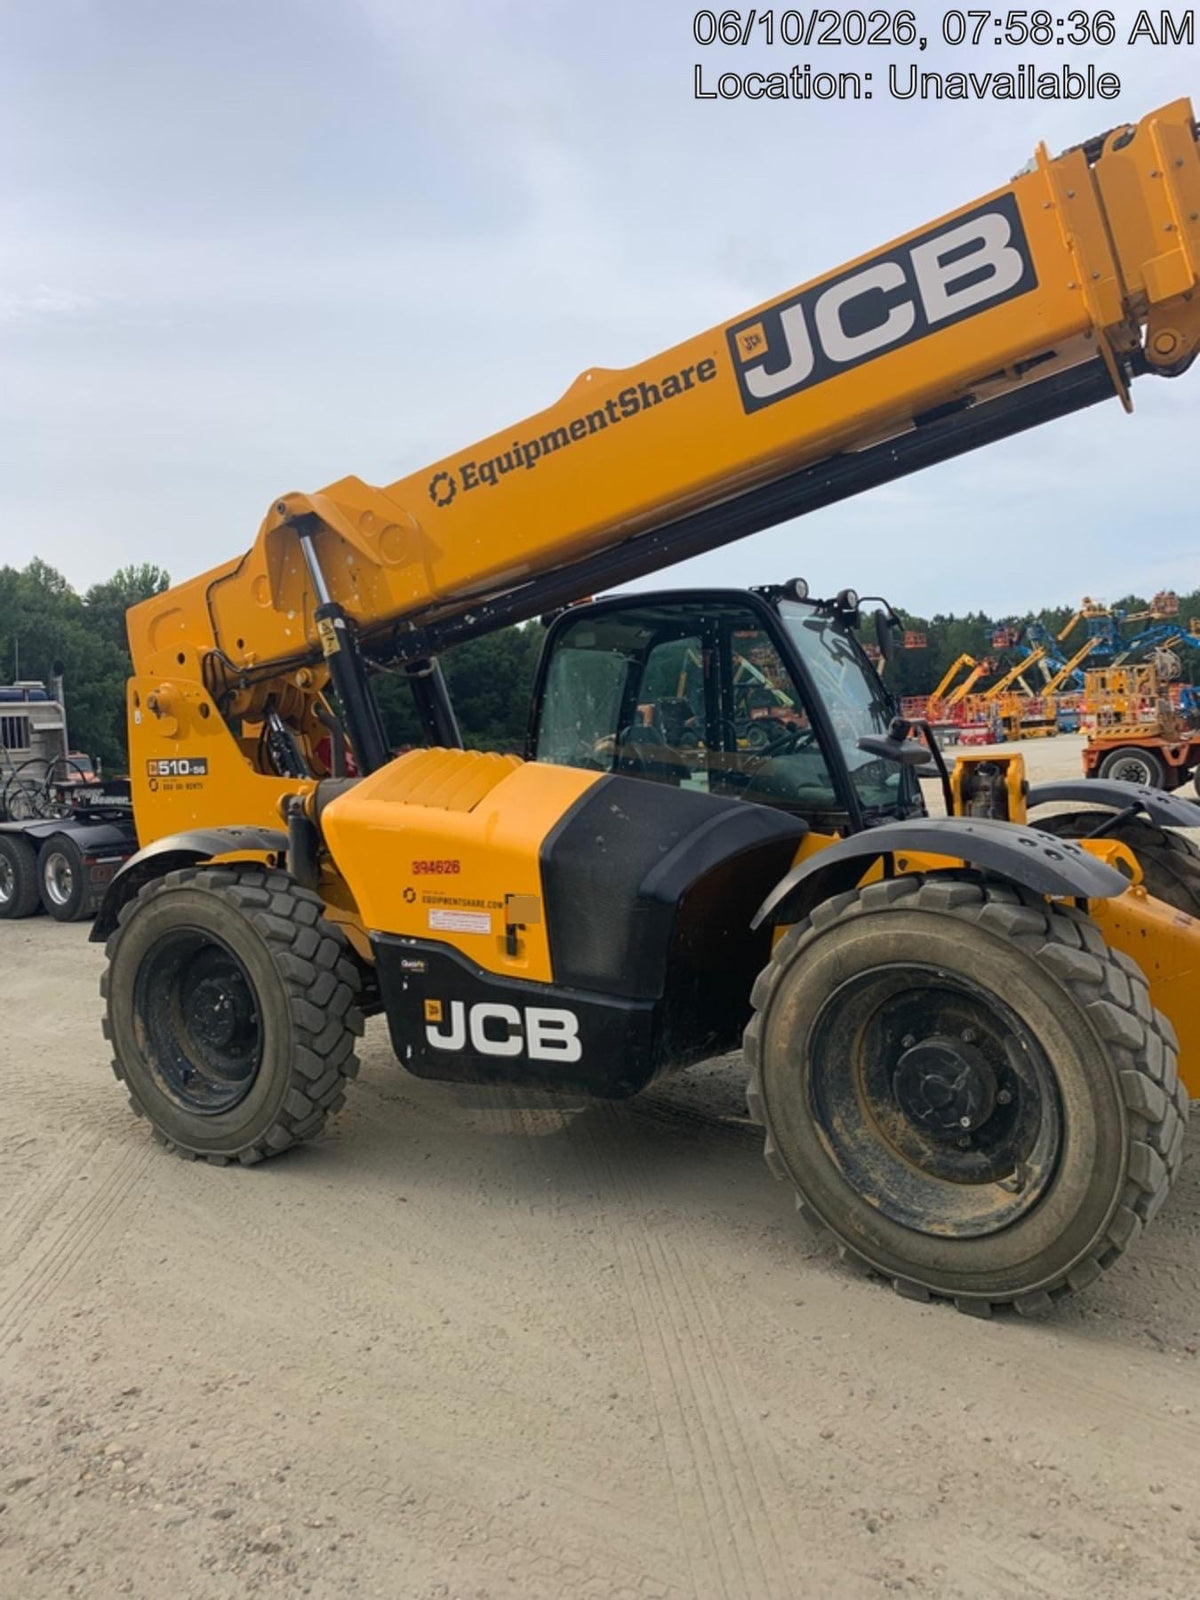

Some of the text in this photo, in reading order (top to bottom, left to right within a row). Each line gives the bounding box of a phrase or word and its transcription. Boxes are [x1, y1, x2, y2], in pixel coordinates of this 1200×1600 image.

[744, 212, 1024, 398] JCB
[459, 357, 718, 491] EquipmentShare
[412, 860, 461, 875] 394626
[425, 1000, 583, 1063] JCB
